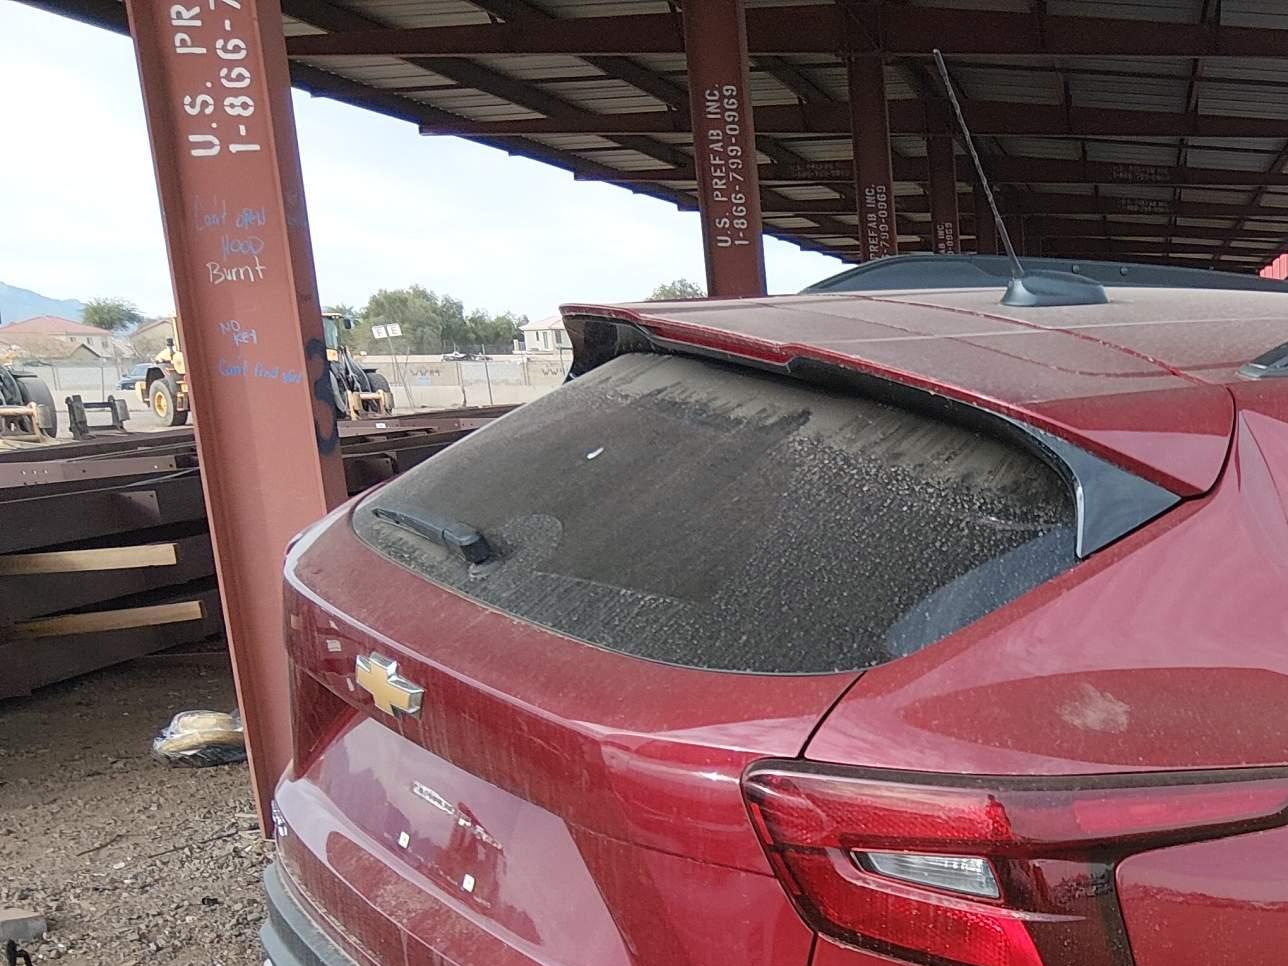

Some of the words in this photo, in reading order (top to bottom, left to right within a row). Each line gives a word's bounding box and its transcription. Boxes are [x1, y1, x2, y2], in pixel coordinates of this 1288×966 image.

[183, 81, 221, 156] U.S.
[704, 83, 721, 119] INC.
[708, 129, 729, 201] PREFAB
[722, 85, 750, 245] 1-866-799-0969
[715, 212, 732, 247] U.S.
[206, 255, 267, 285] Burnt
